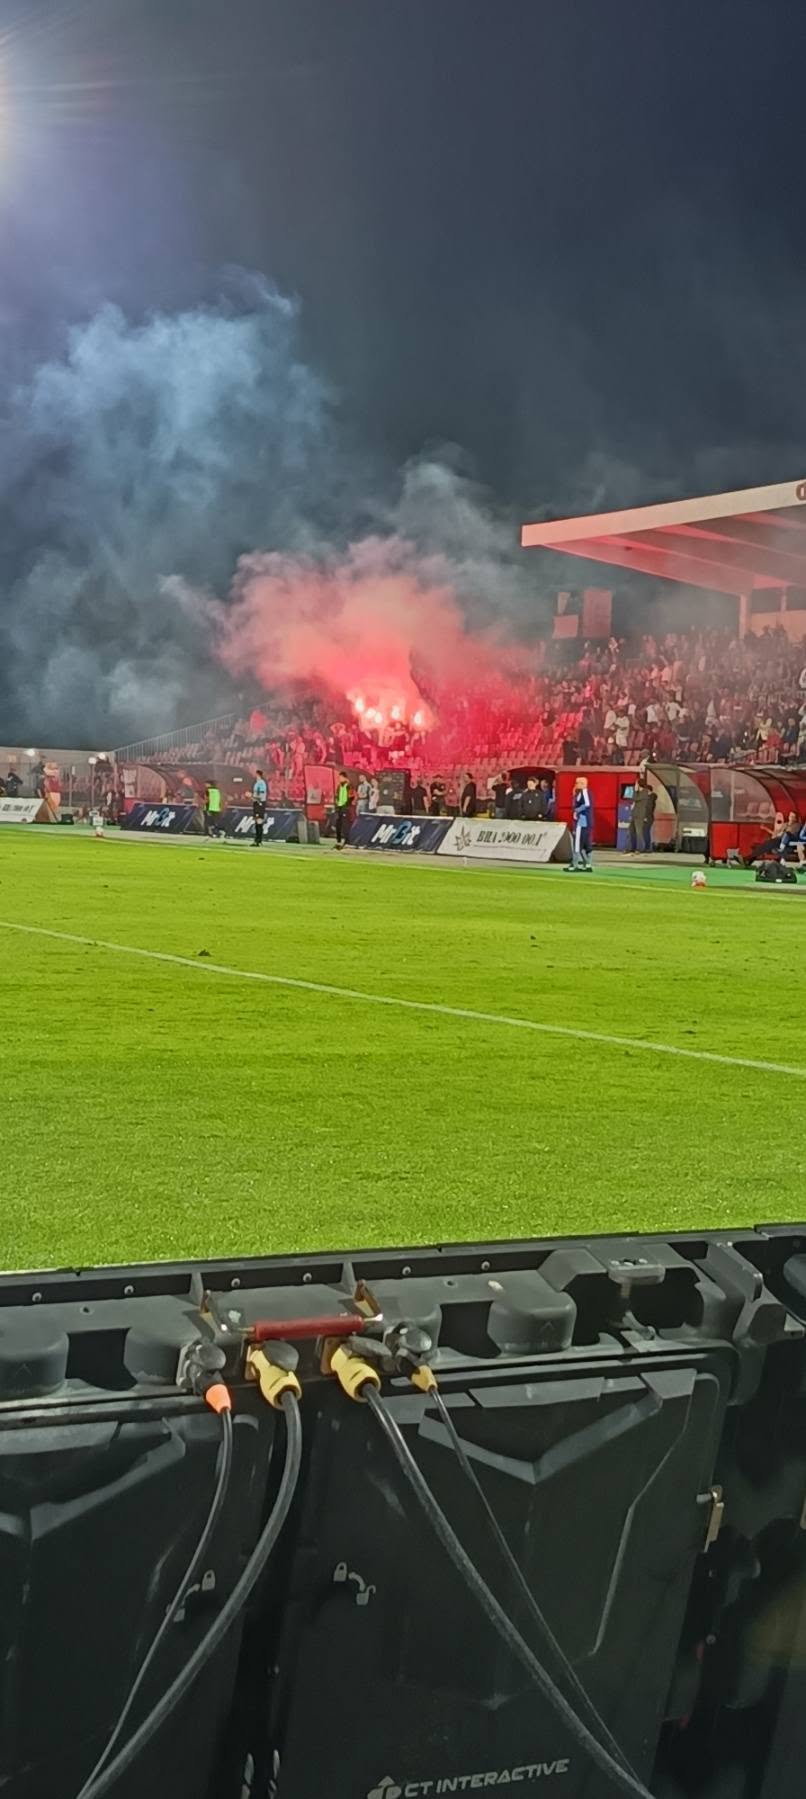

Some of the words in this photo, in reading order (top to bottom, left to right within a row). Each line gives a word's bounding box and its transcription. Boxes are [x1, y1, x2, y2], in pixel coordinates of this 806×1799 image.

[371, 820, 421, 845] MrBit
[404, 1780, 434, 1798] CT
[436, 1758, 570, 1794] INTERACTIVE
